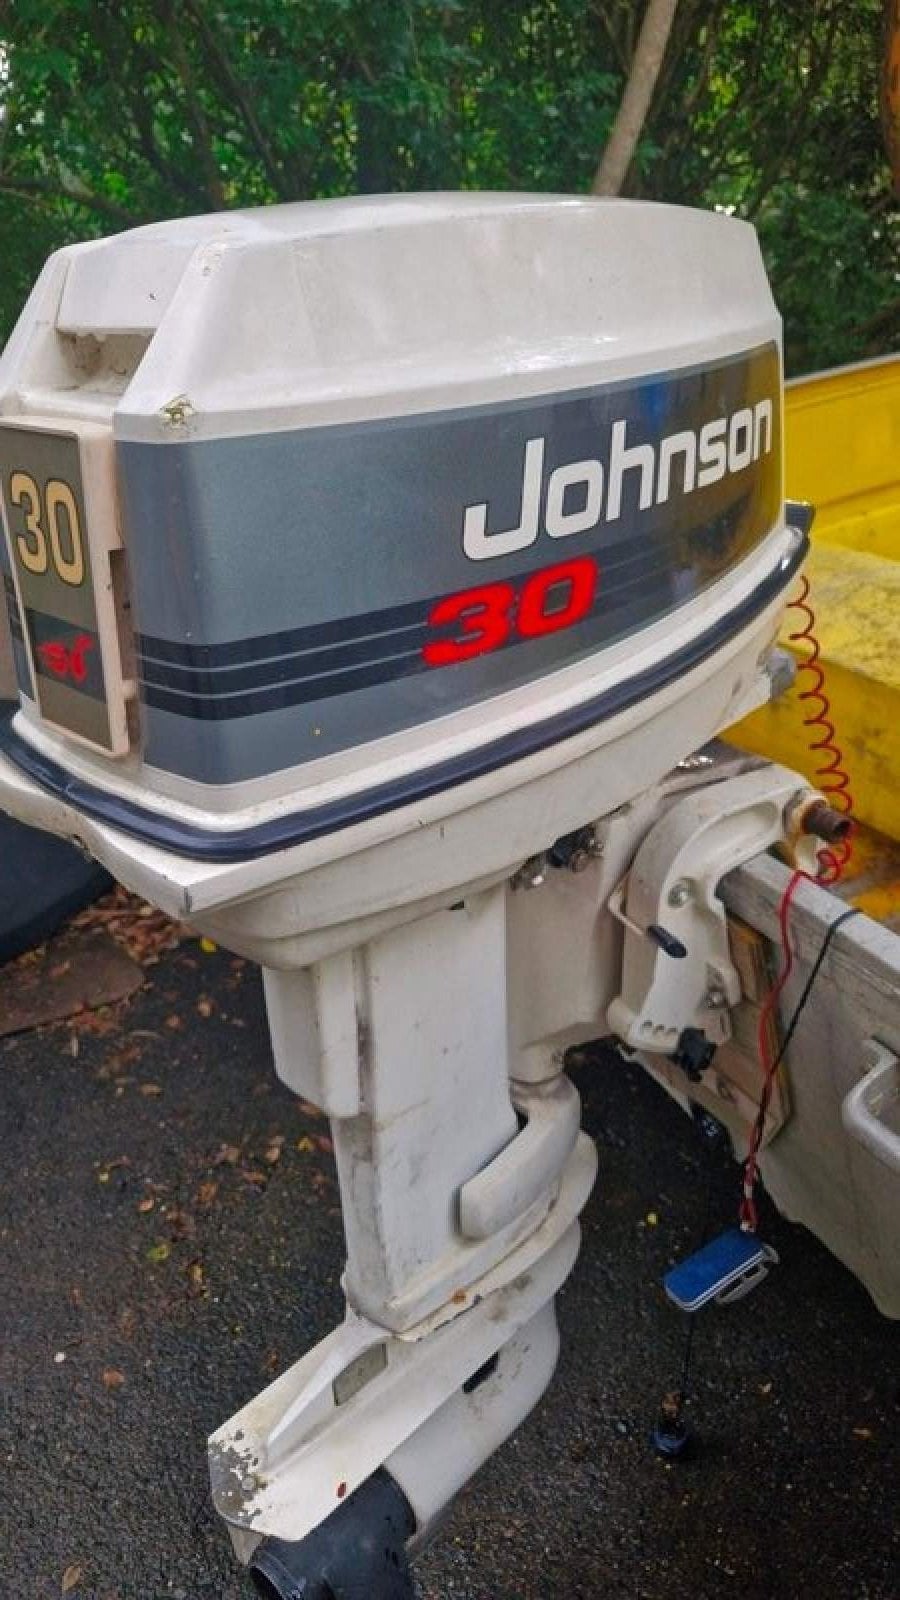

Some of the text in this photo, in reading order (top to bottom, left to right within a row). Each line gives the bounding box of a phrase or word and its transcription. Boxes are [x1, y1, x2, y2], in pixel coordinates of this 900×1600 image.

[10, 471, 84, 587] 30
[463, 399, 772, 560] Johnson
[422, 555, 598, 667] 30
